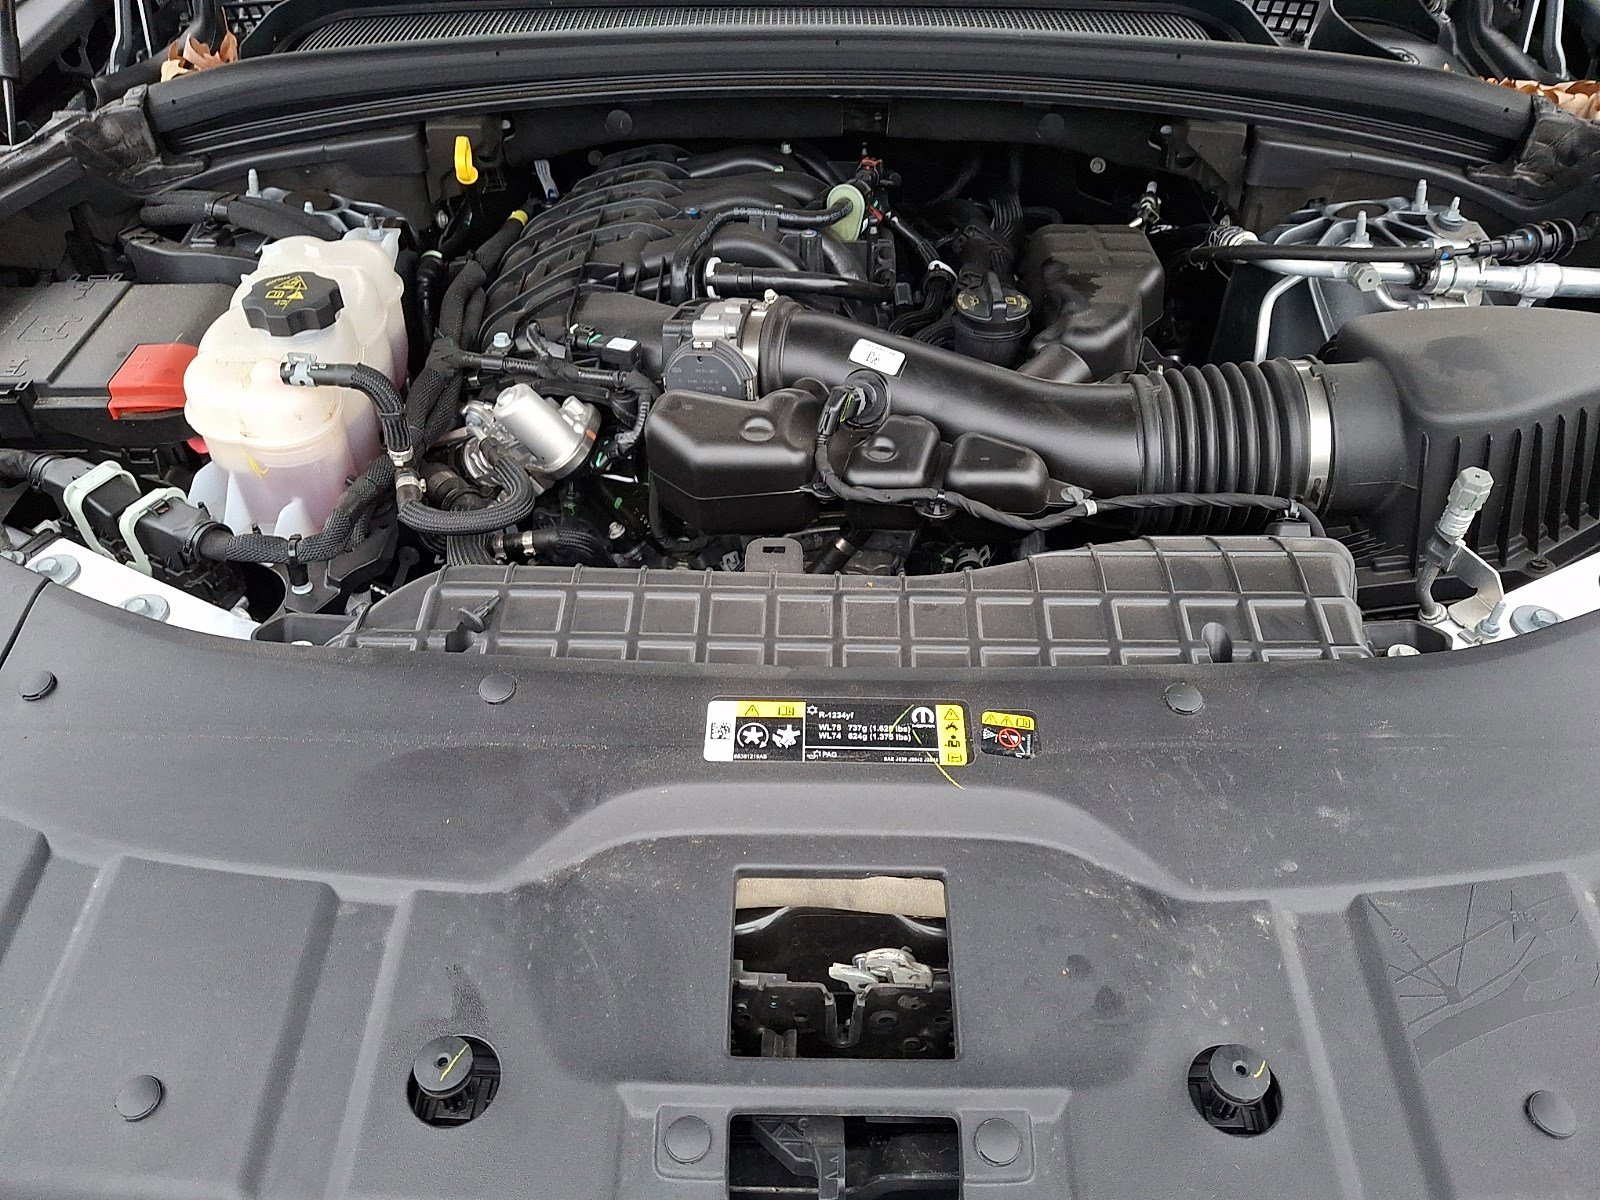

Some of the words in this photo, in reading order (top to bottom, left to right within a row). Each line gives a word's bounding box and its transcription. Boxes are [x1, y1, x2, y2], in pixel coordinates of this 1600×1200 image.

[818, 711, 854, 721] R-1234yf
[848, 724, 868, 734] 737g
[818, 731, 842, 740] WL74
